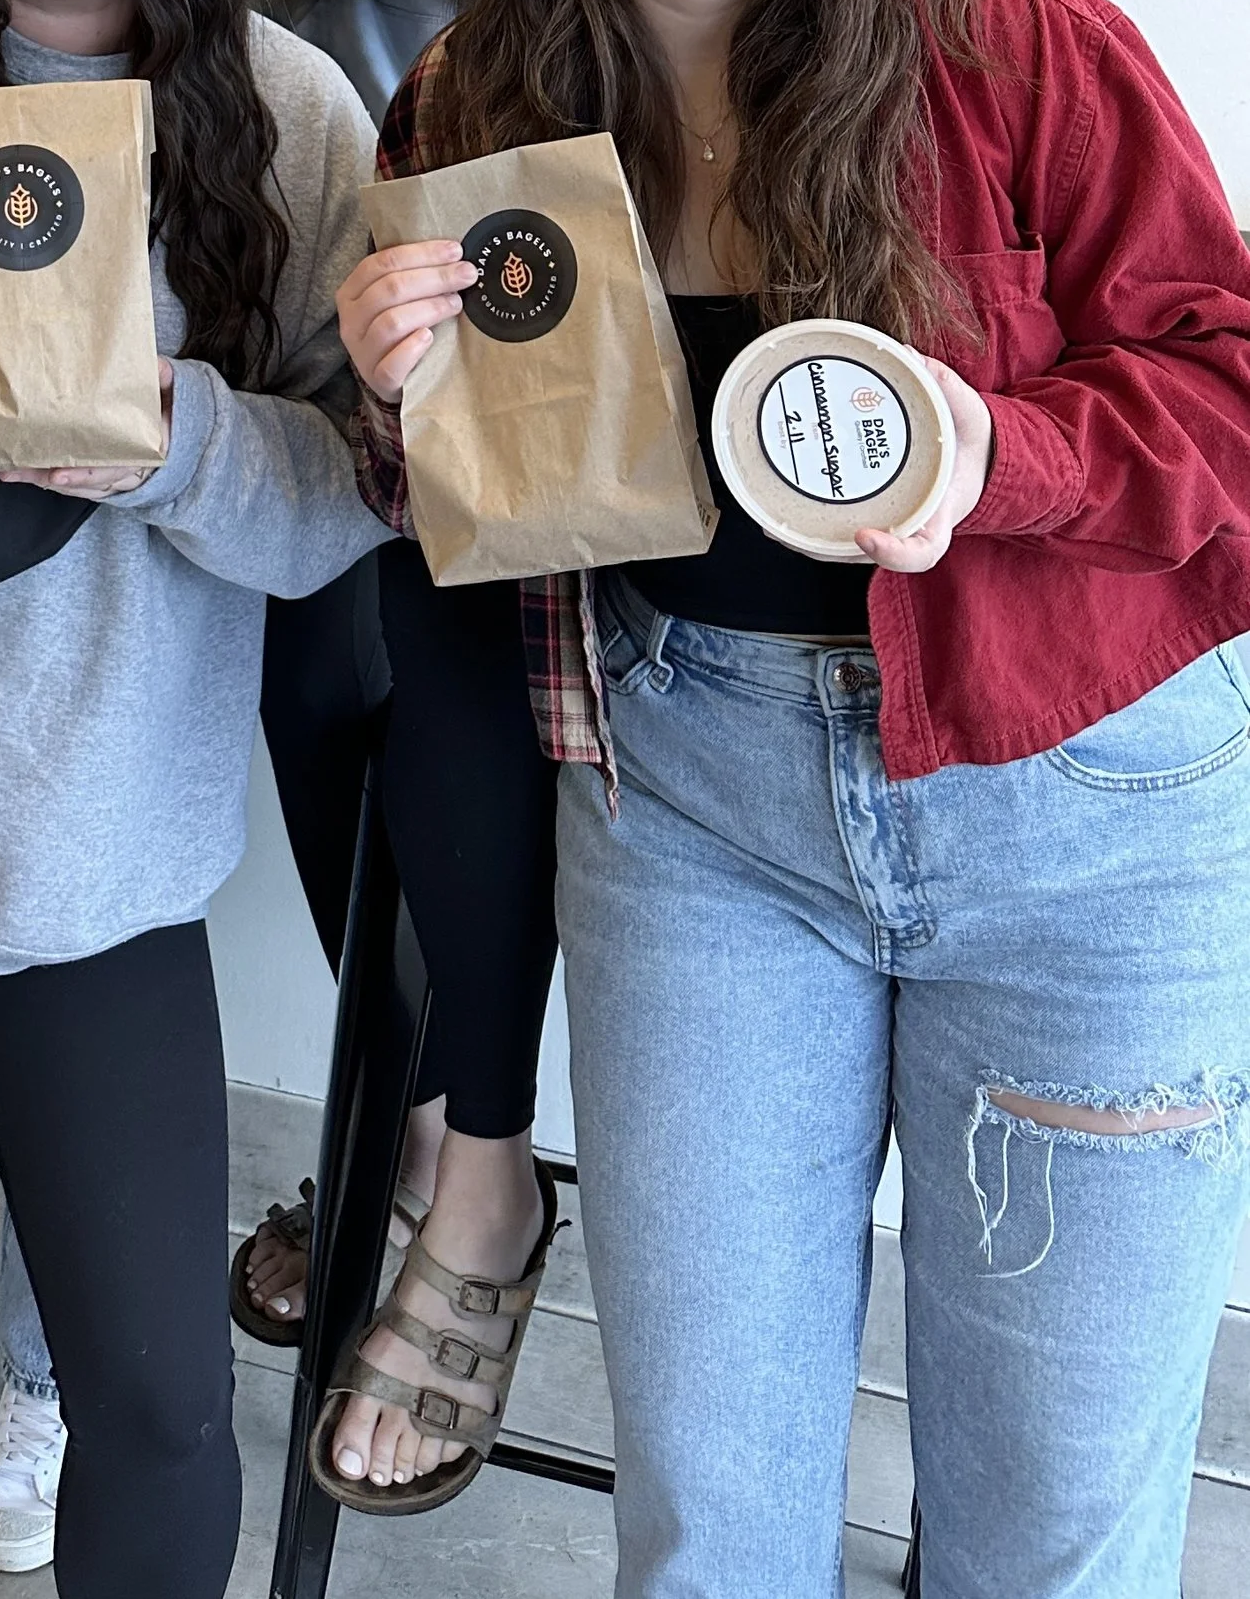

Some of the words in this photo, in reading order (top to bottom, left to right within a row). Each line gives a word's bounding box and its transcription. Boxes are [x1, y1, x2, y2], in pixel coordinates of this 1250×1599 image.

[17, 163, 62, 197] BAGELS
[29, 214, 63, 249] CRAFTED
[506, 230, 552, 258] BAGELS
[481, 294, 517, 320] QUALITY
[529, 275, 557, 317] CRAFTED
[861, 419, 881, 470] BAGELS
[873, 418, 890, 459] DAN'S
